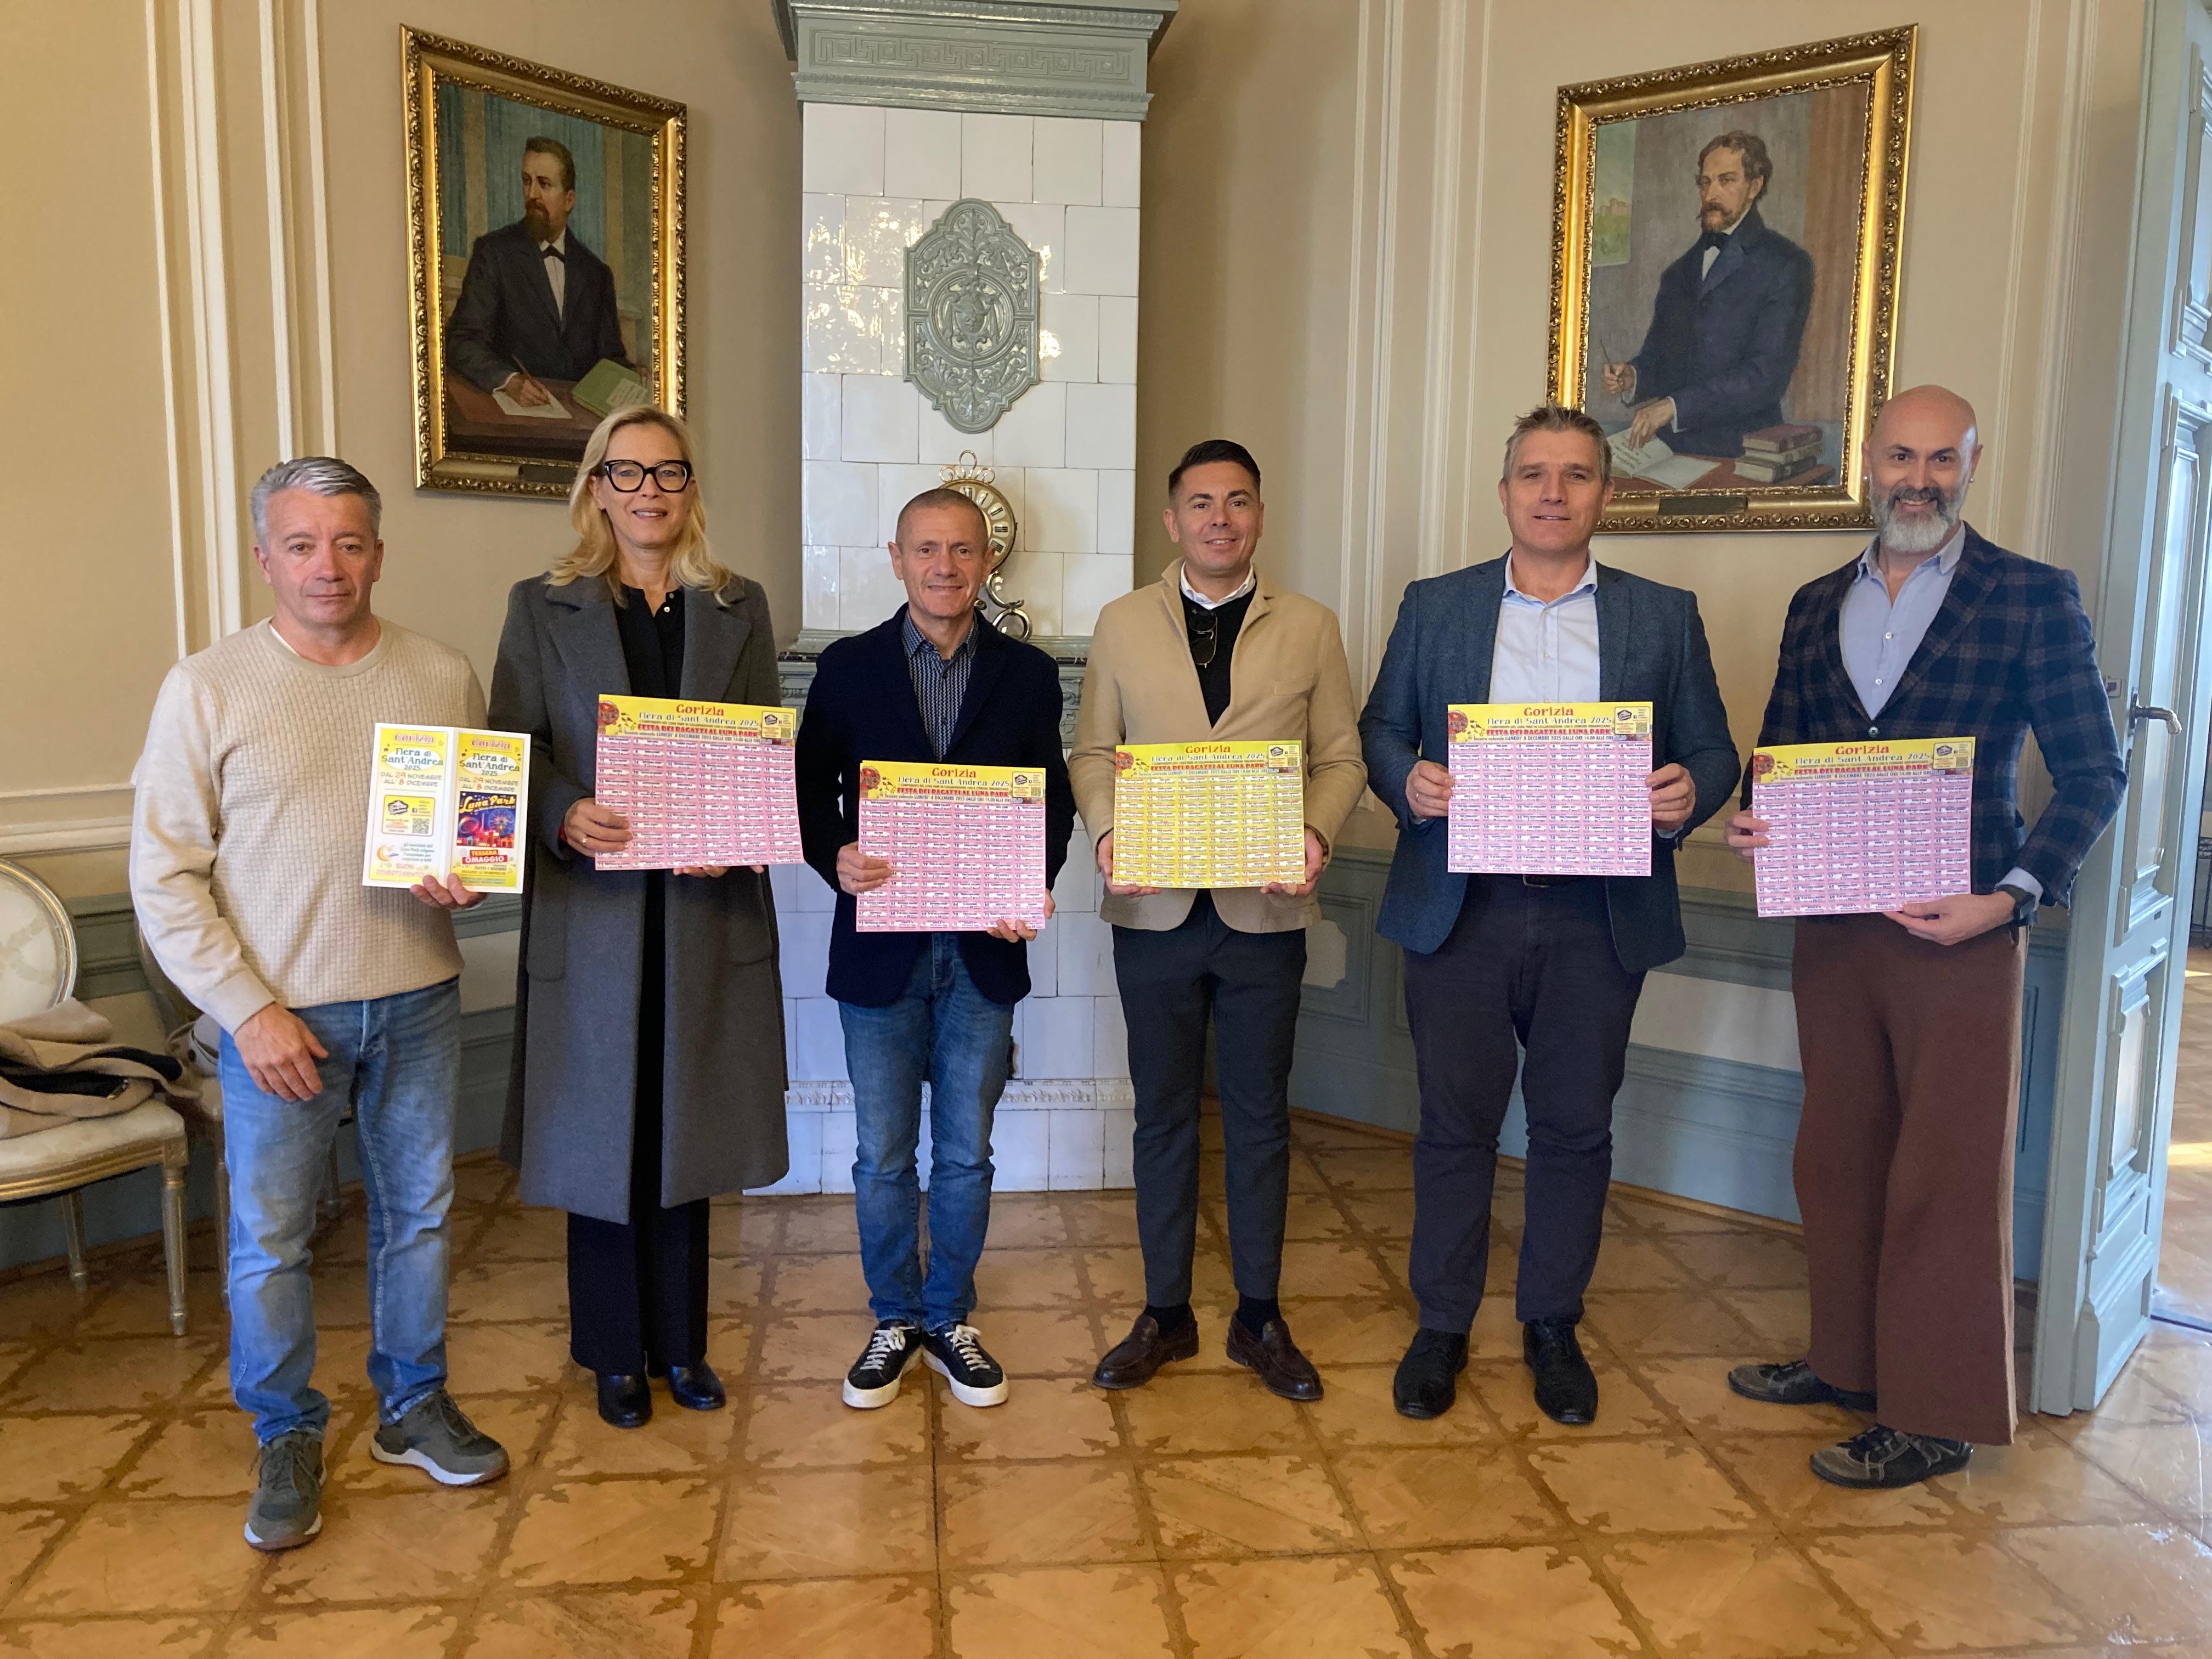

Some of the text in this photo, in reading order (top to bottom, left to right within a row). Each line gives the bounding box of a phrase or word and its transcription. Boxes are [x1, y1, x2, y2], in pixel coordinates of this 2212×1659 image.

[676, 704, 724, 716] Gorizia
[1523, 707, 1573, 716] Gorizia
[396, 748, 420, 756] Fiera
[1185, 745, 1231, 753] Gorizia
[1835, 745, 1889, 754] Gorizia
[381, 755, 443, 765] Sant'Andrea
[473, 753, 496, 761] Fiera
[459, 760, 520, 771] Sant'Andrea
[932, 768, 976, 778] Gorizia
[459, 795, 515, 813] Luna Park
